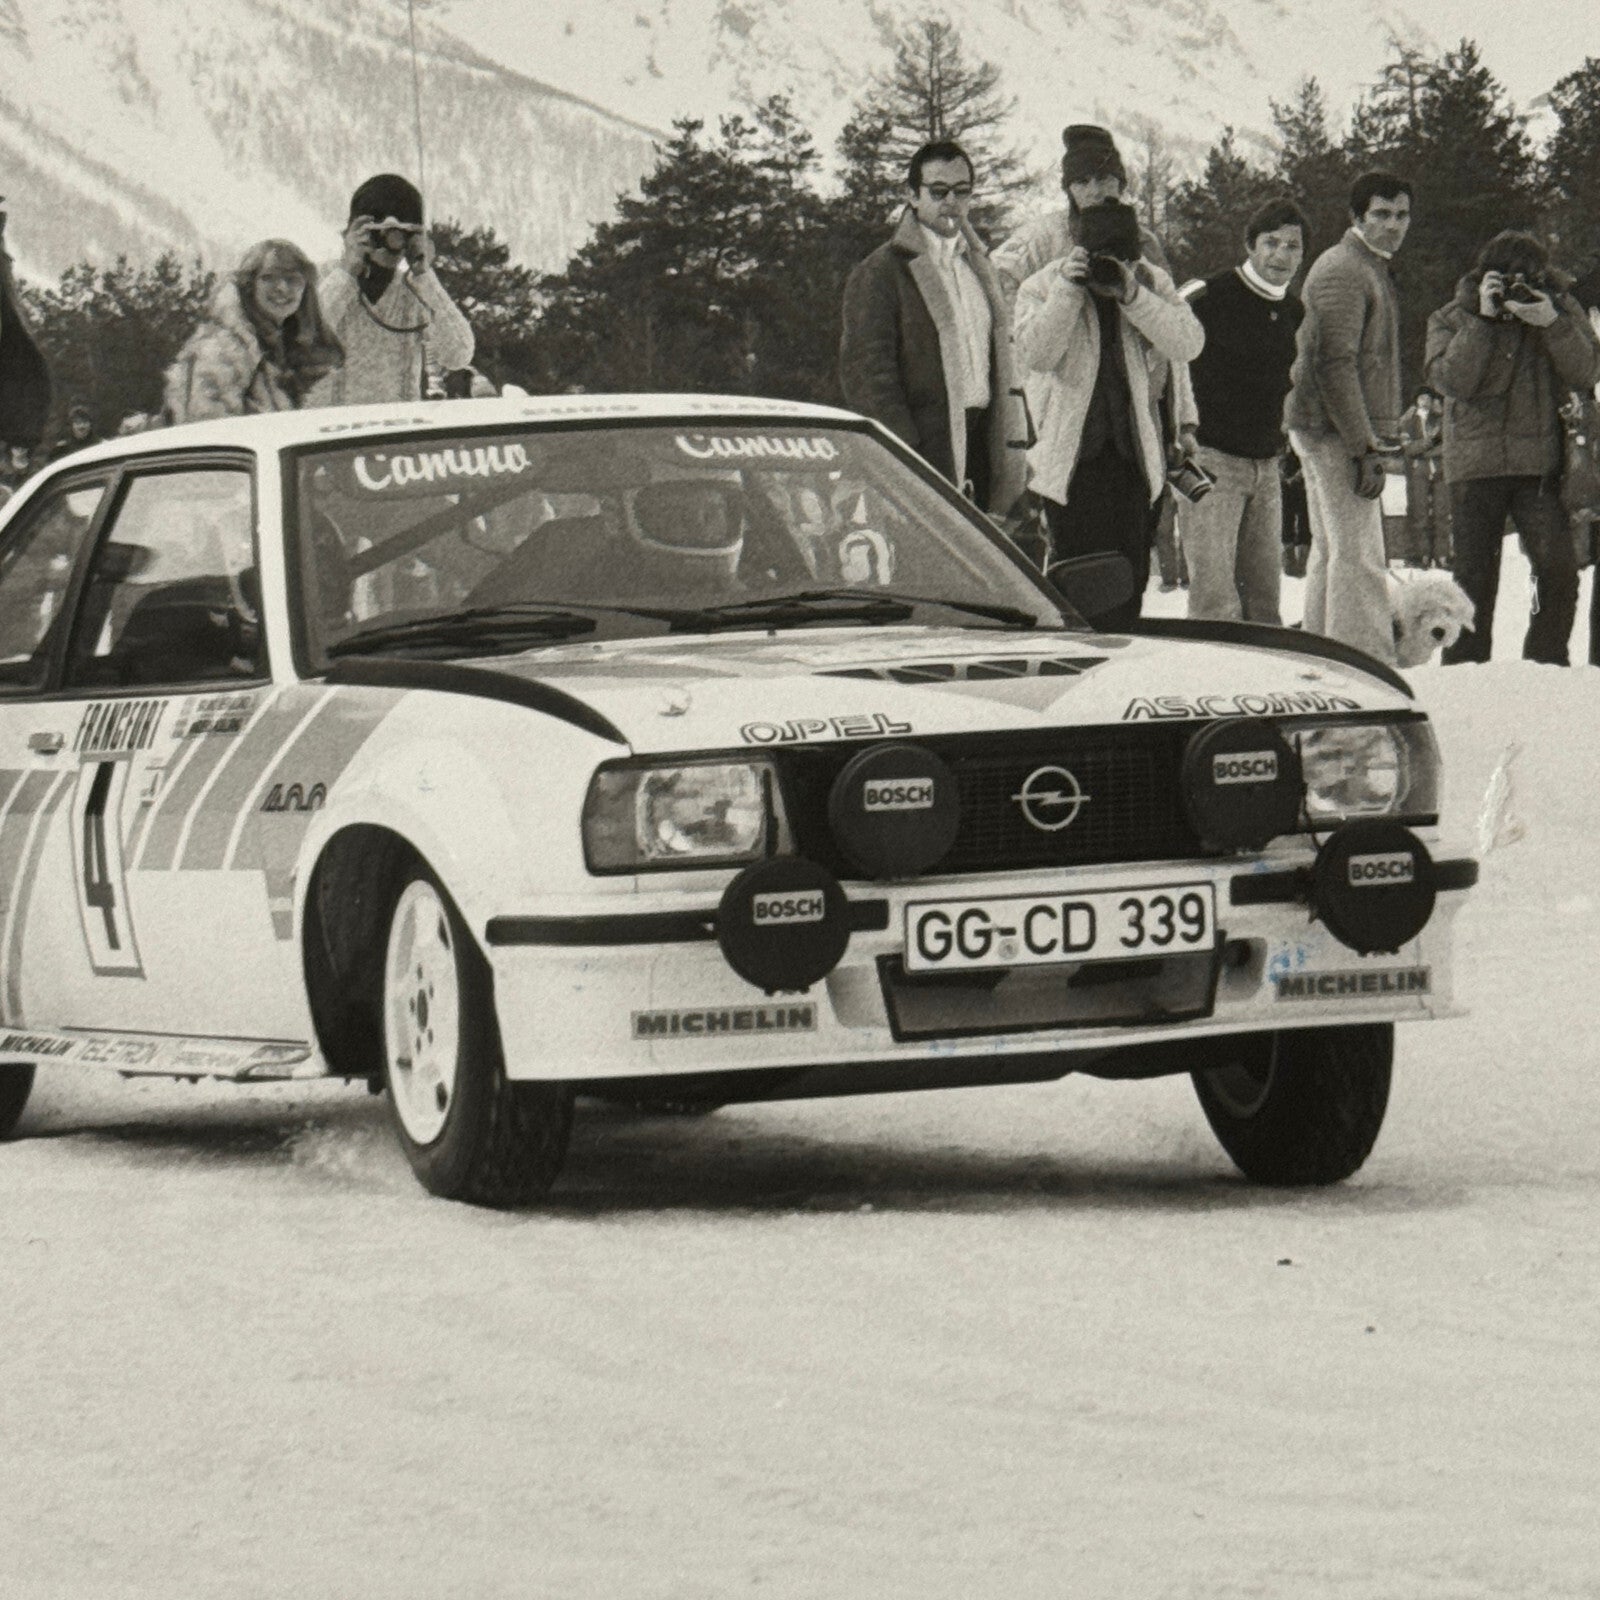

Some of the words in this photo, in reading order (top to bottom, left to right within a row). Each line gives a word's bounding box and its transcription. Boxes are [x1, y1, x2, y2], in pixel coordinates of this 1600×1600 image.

[674, 433, 839, 461] Camino
[352, 443, 532, 491] Camino
[1121, 691, 1361, 721] ASCONA
[73, 699, 169, 752] FRANCFORT
[740, 712, 912, 744] OPEL
[1214, 755, 1277, 779] BOSCH
[864, 781, 934, 806] BOSCH
[1351, 854, 1413, 881] BOSCH
[755, 896, 823, 919] BOSCH
[916, 901, 1097, 961] GG-CD
[1118, 892, 1207, 949] 339
[1277, 970, 1428, 997] MICHELIN
[636, 1006, 812, 1034] MICHELIN
[0, 1034, 76, 1056] MICHELIN
